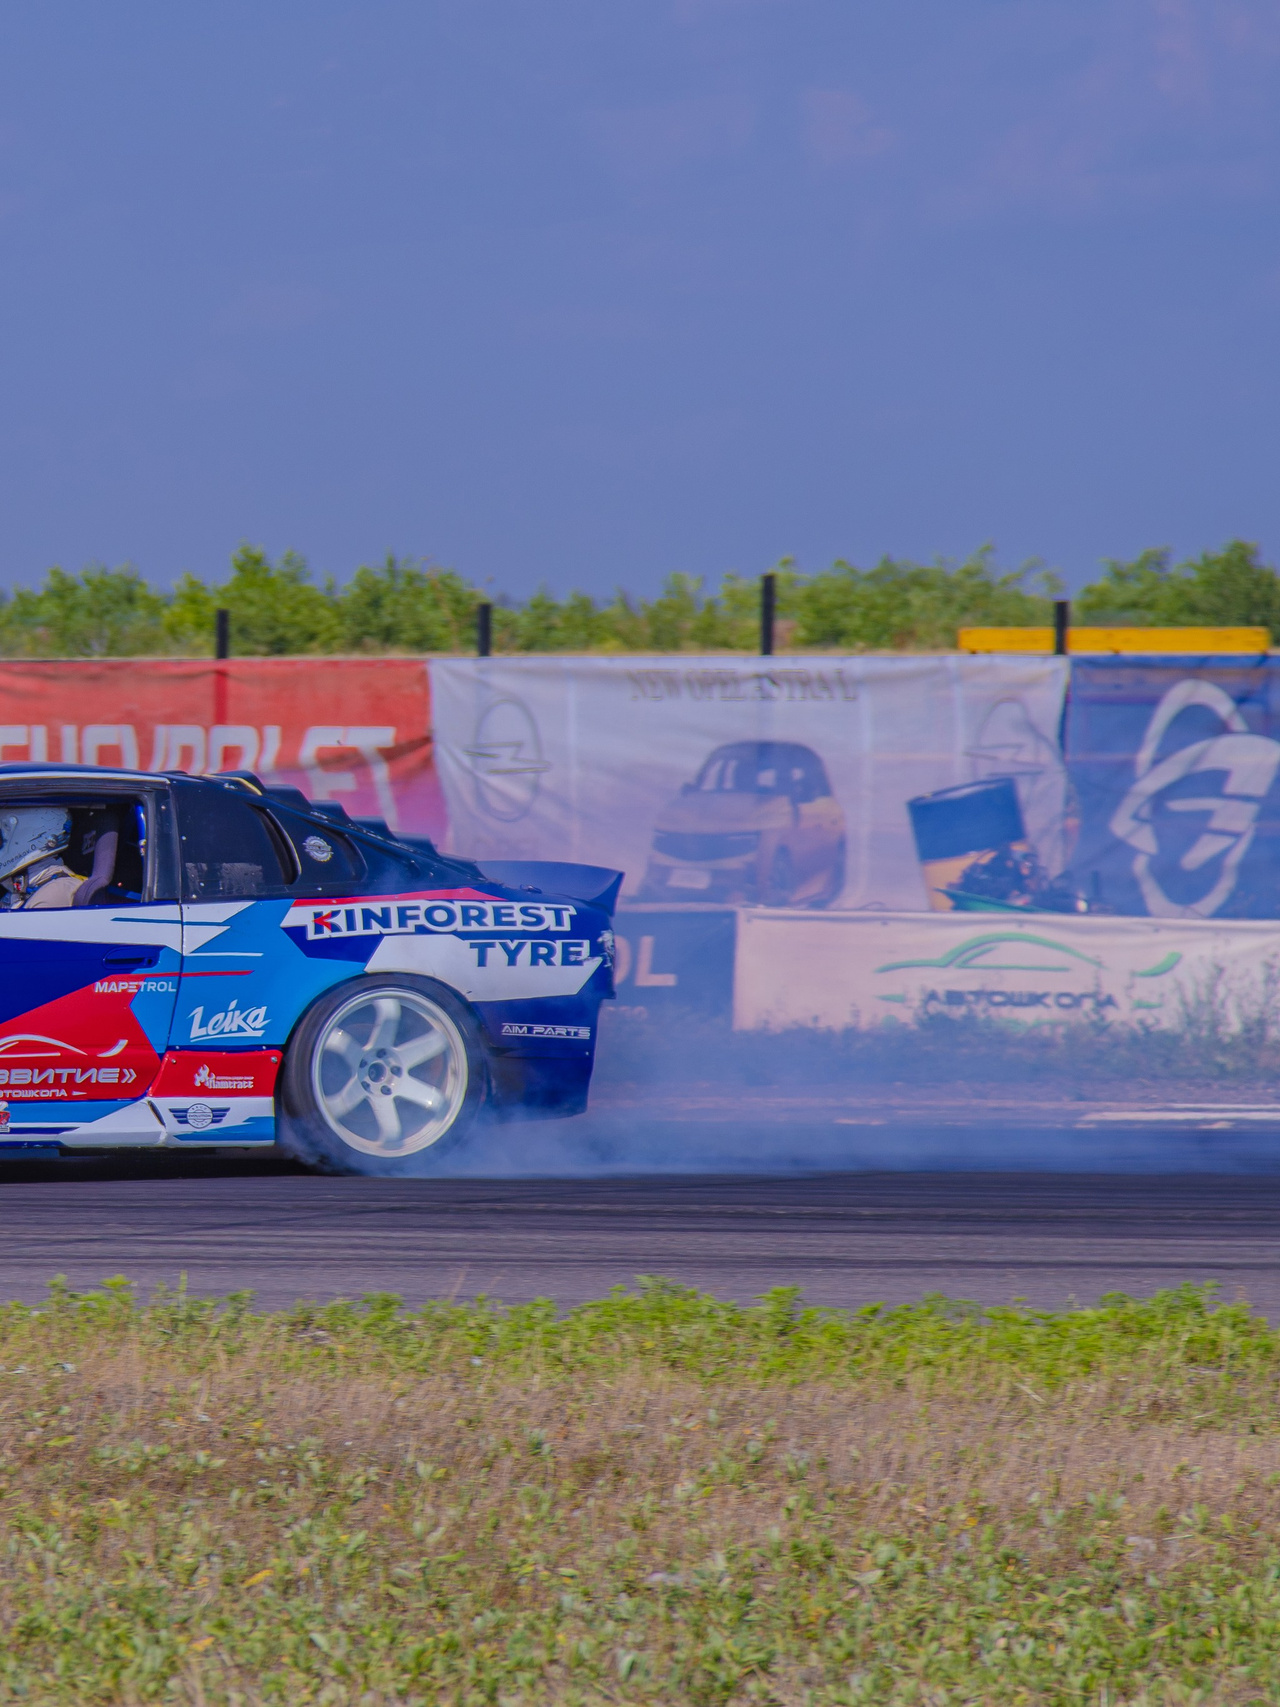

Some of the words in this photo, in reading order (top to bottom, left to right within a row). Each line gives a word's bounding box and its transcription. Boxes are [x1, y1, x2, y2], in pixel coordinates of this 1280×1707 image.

[312, 905, 573, 935] KINFOREST
[470, 942, 584, 967] TYRE
[94, 981, 177, 993] MAPETROL
[502, 1025, 528, 1034] AIM
[533, 1026, 590, 1037] PARTS
